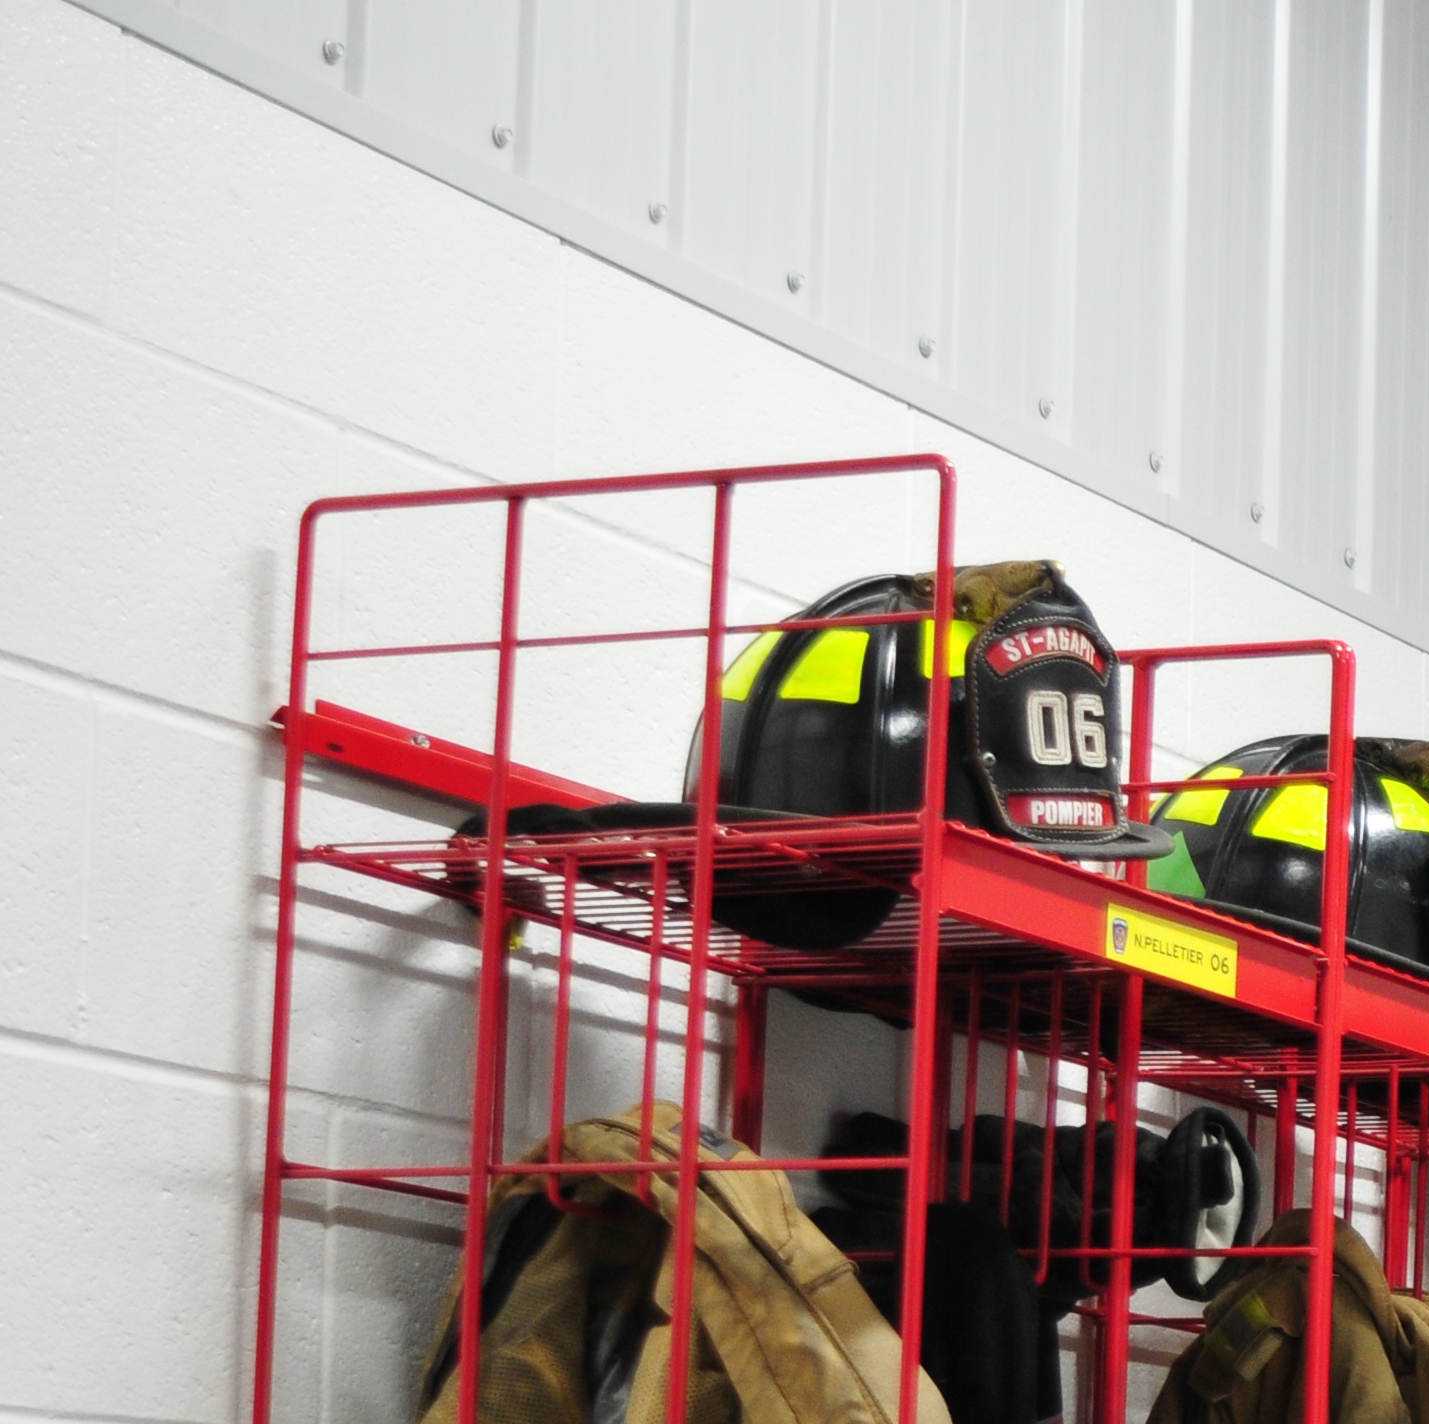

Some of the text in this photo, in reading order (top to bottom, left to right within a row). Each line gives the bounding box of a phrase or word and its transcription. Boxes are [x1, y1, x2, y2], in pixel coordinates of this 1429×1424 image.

[1001, 626, 1096, 666] ST-AGAPIT
[1027, 690, 1107, 768] 06
[1030, 800, 1104, 826] POMPIER
[1134, 933, 1229, 974] N.PELLETIER 06
